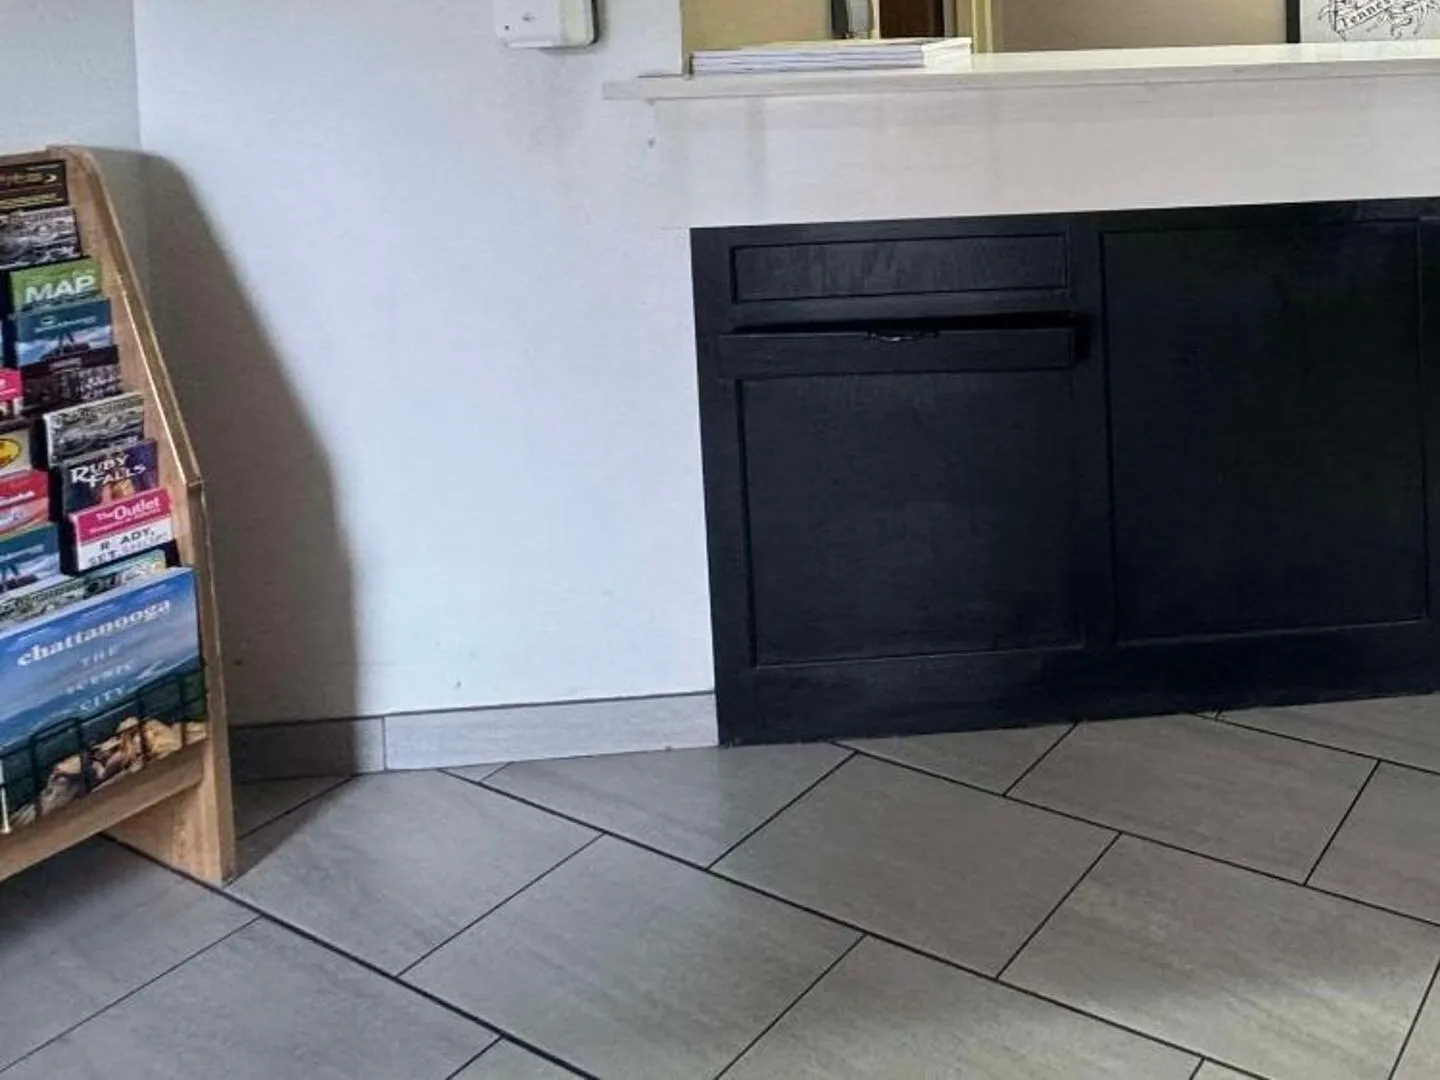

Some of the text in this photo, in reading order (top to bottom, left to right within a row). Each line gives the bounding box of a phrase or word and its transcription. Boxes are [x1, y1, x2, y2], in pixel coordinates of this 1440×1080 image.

[25, 275, 96, 303] MAP
[114, 496, 161, 521] Outlet
[16, 600, 171, 666] chattanooga
